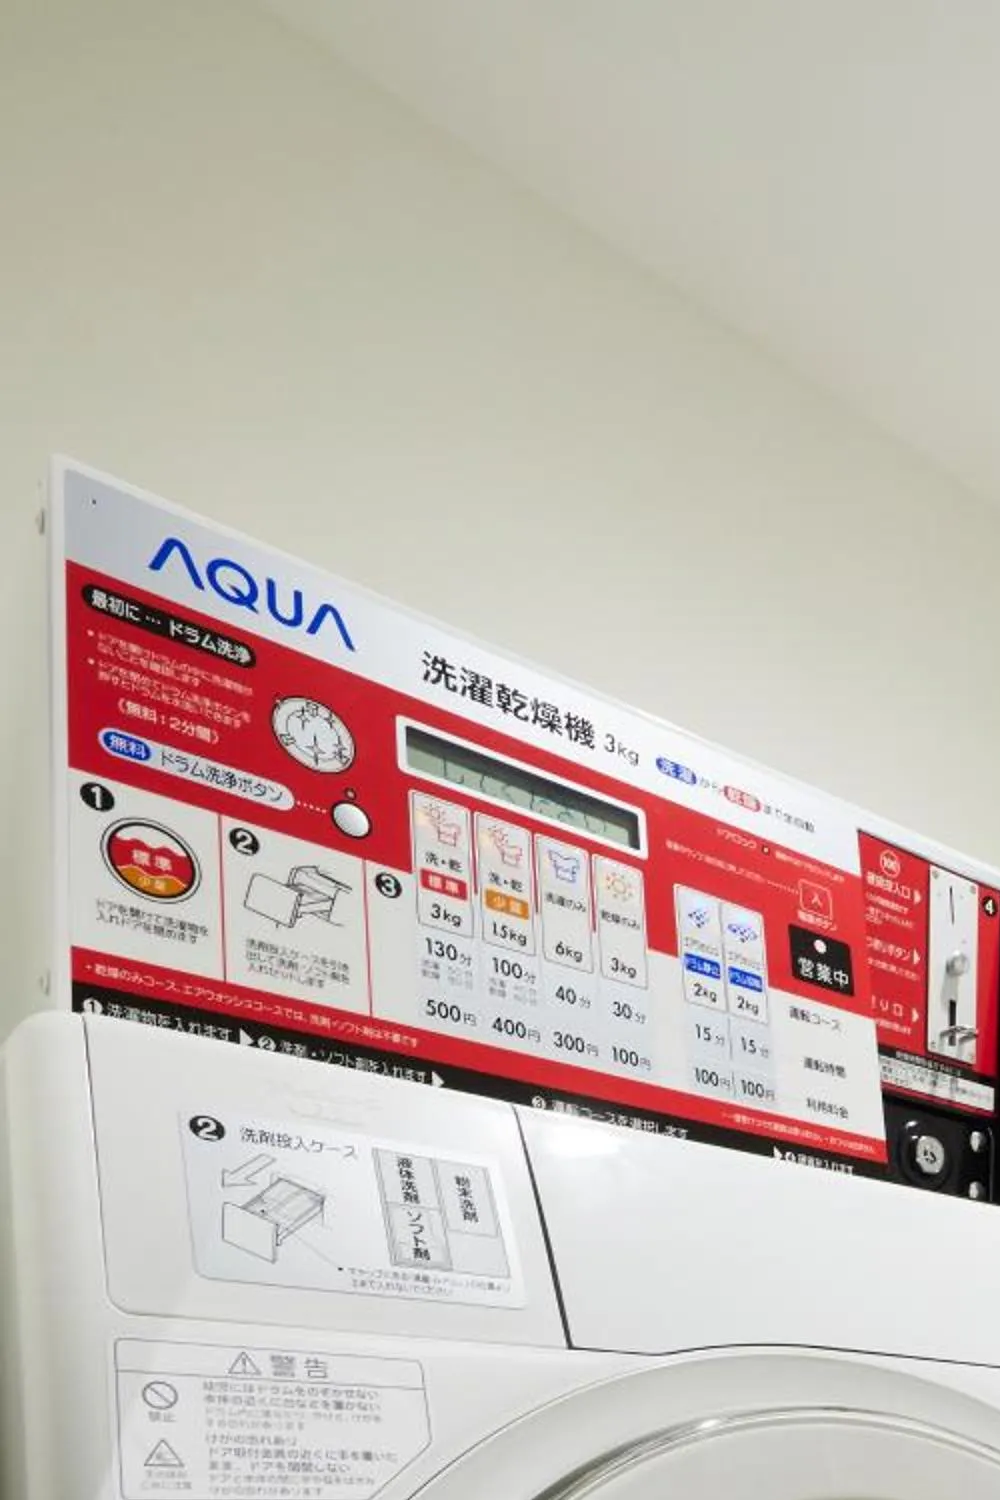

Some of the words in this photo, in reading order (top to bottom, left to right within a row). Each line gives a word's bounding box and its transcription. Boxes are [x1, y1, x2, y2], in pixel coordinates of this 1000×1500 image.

[148, 536, 357, 652] AQUA
[421, 650, 596, 750] 洗濯乾燥機
[603, 733, 640, 766] 3kg
[160, 750, 285, 802] ドラム洗浄ボタン
[430, 903, 462, 928] 3kg
[425, 936, 473, 967] 130分
[555, 941, 583, 963] 6kg
[610, 956, 637, 979] 3kg
[797, 956, 850, 988] 営業中
[692, 982, 718, 1003] 2kg
[736, 995, 759, 1017] 2kg
[425, 999, 478, 1027] 500円
[491, 1016, 541, 1043] 400円
[553, 1031, 600, 1057] 300円
[611, 1046, 652, 1072] 100円
[239, 1126, 358, 1160] 洗剤投入ケース
